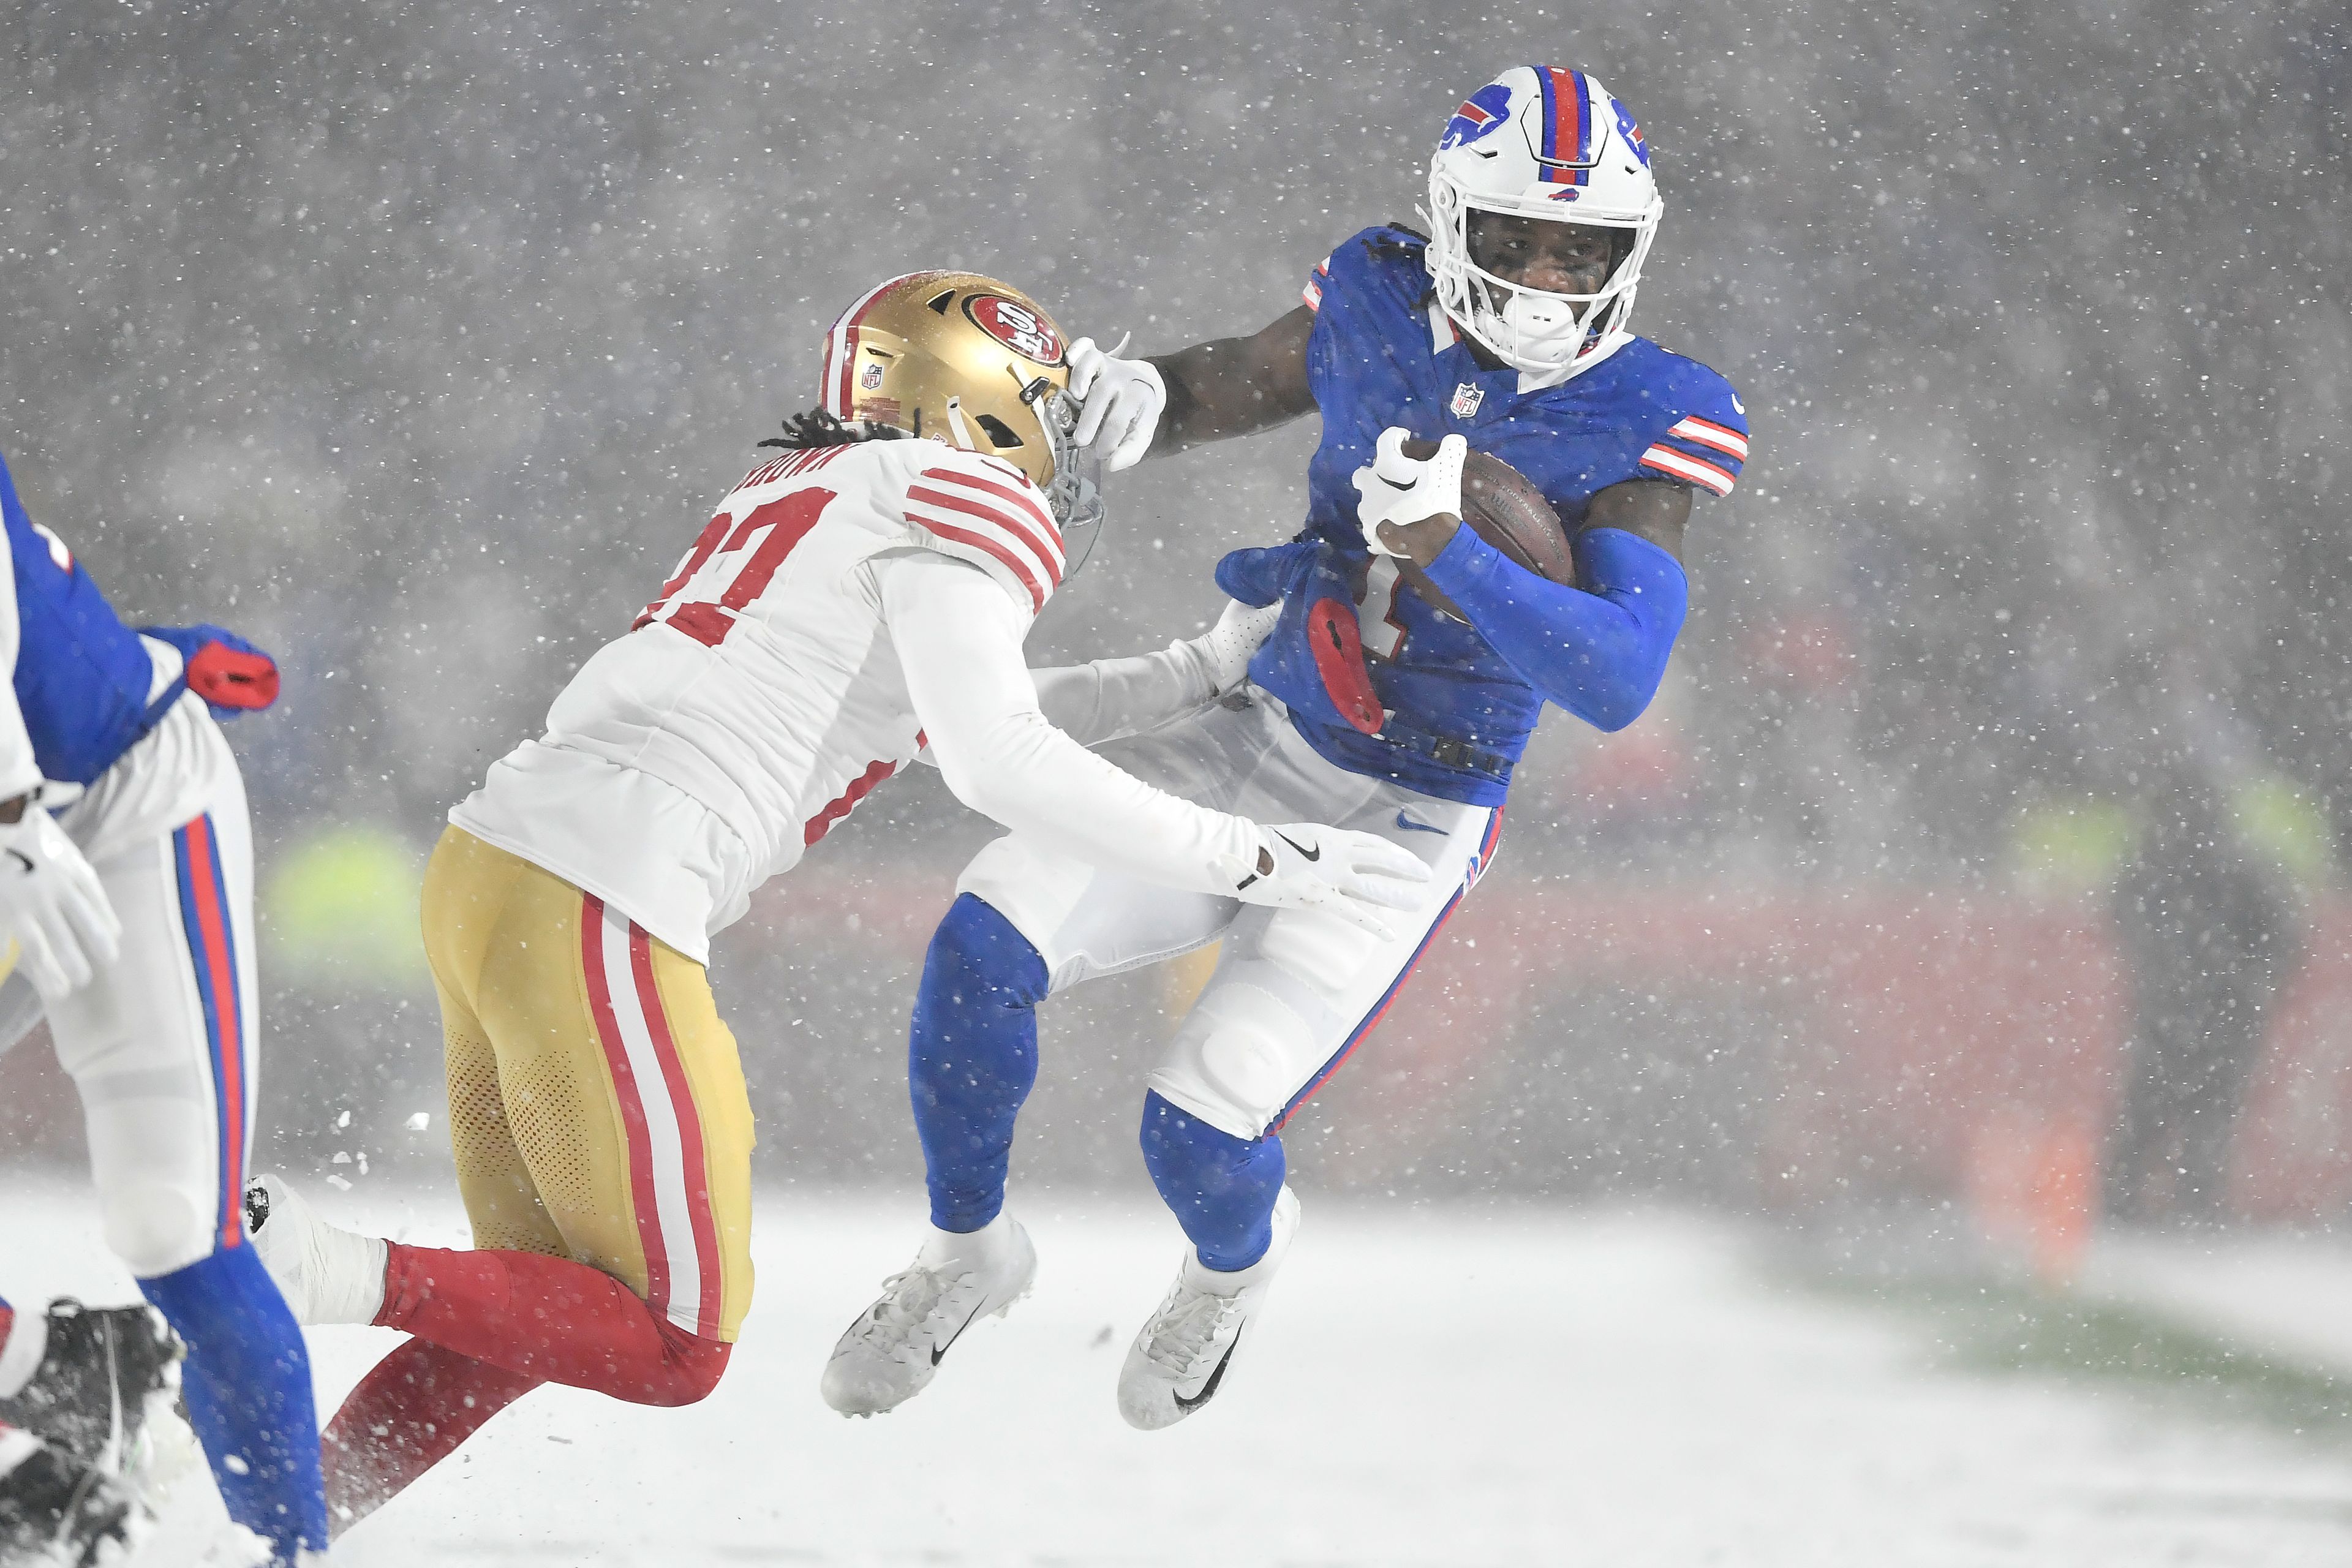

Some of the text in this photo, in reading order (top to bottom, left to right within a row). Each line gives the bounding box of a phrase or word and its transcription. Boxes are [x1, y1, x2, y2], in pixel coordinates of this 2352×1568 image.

[863, 374, 880, 386] NFL
[1455, 396, 1473, 412] NFL
[1501, 484, 1542, 526] FOOTBALL
